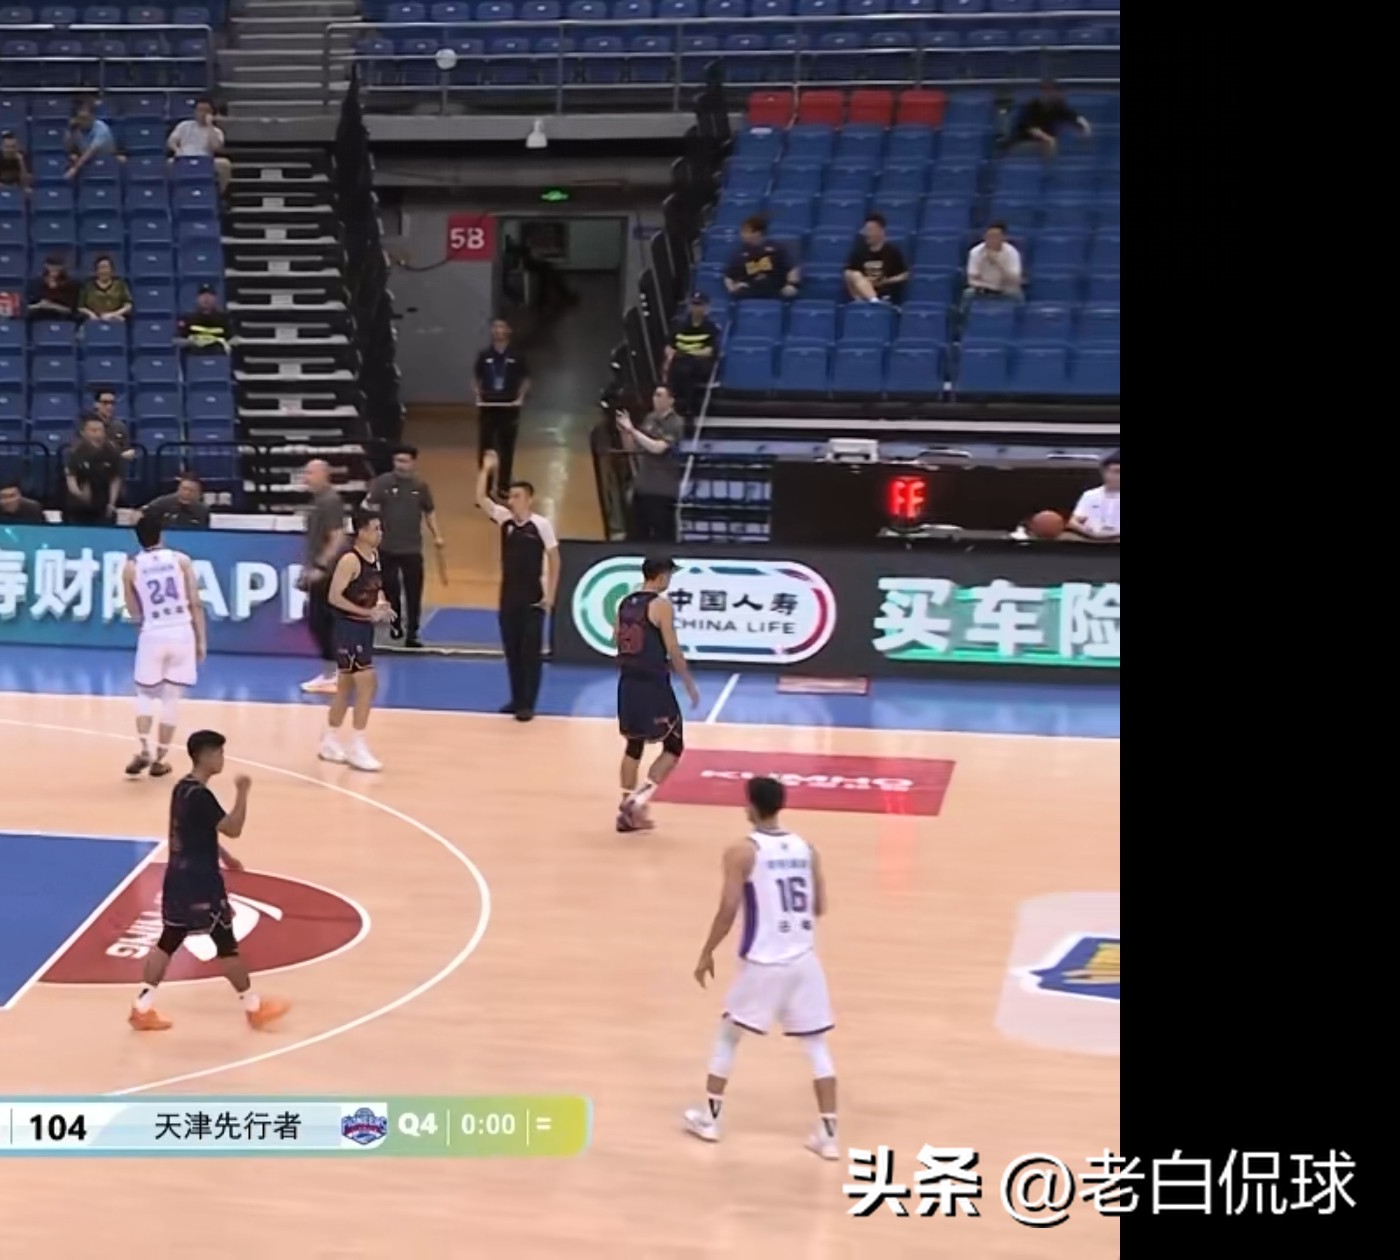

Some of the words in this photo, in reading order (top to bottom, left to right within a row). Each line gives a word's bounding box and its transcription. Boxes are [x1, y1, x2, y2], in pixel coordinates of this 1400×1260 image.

[450, 227, 484, 249] 5B
[147, 576, 179, 604] 24
[669, 588, 798, 616] 中国人寿
[673, 618, 737, 632] CHINA
[747, 621, 796, 634] LIFE
[872, 577, 1120, 660] 买车险
[775, 876, 807, 912] 16
